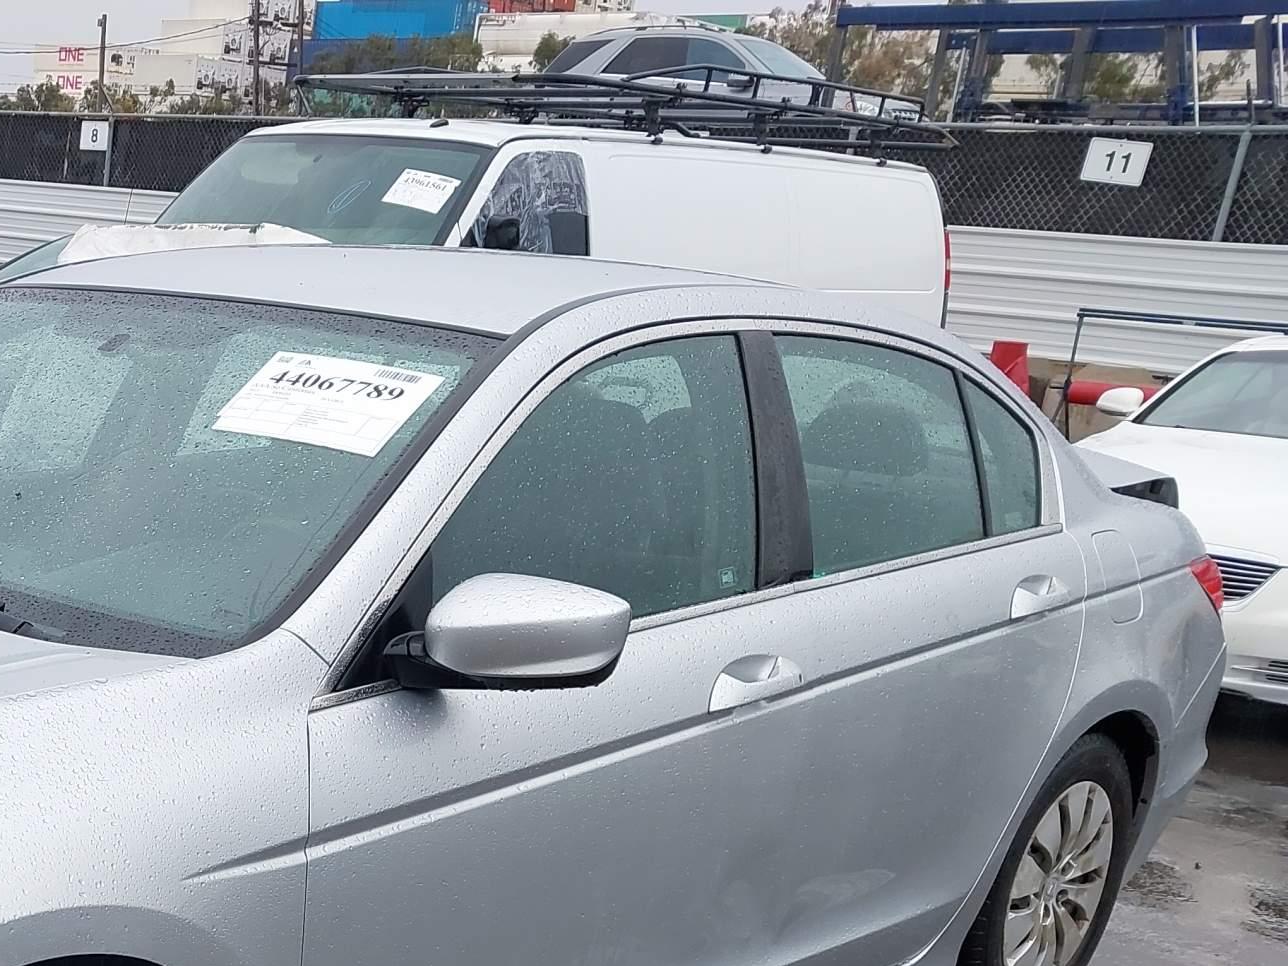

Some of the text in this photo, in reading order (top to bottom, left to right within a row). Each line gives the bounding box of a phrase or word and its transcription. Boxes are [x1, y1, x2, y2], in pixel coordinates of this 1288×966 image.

[58, 47, 84, 62] ONE
[56, 75, 82, 90] ONE
[91, 128, 99, 143] 8
[1105, 150, 1132, 174] 11
[269, 369, 405, 401] 44067789
